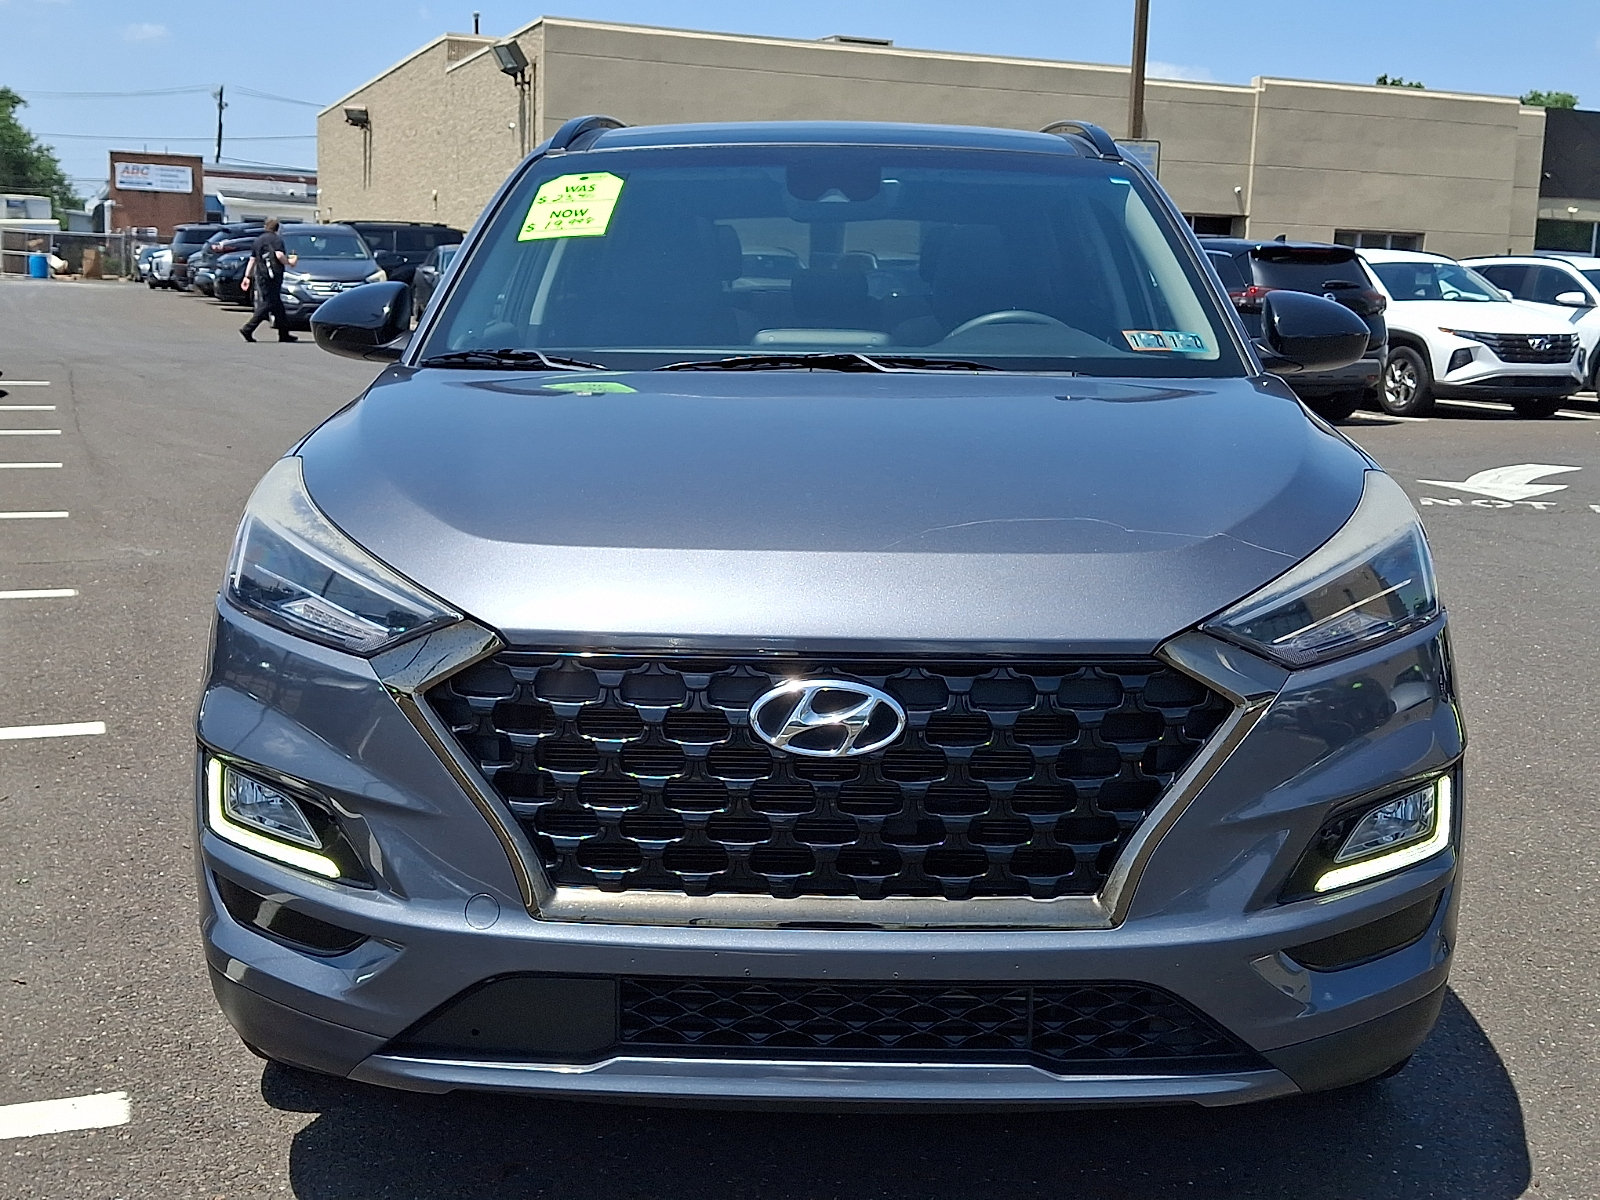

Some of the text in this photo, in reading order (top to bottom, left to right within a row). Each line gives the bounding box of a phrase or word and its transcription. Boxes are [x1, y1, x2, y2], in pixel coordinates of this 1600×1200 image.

[121, 164, 150, 176] ABC
[565, 184, 596, 193] WAS
[549, 208, 590, 219] NOW
[1419, 497, 1558, 510] NOT
